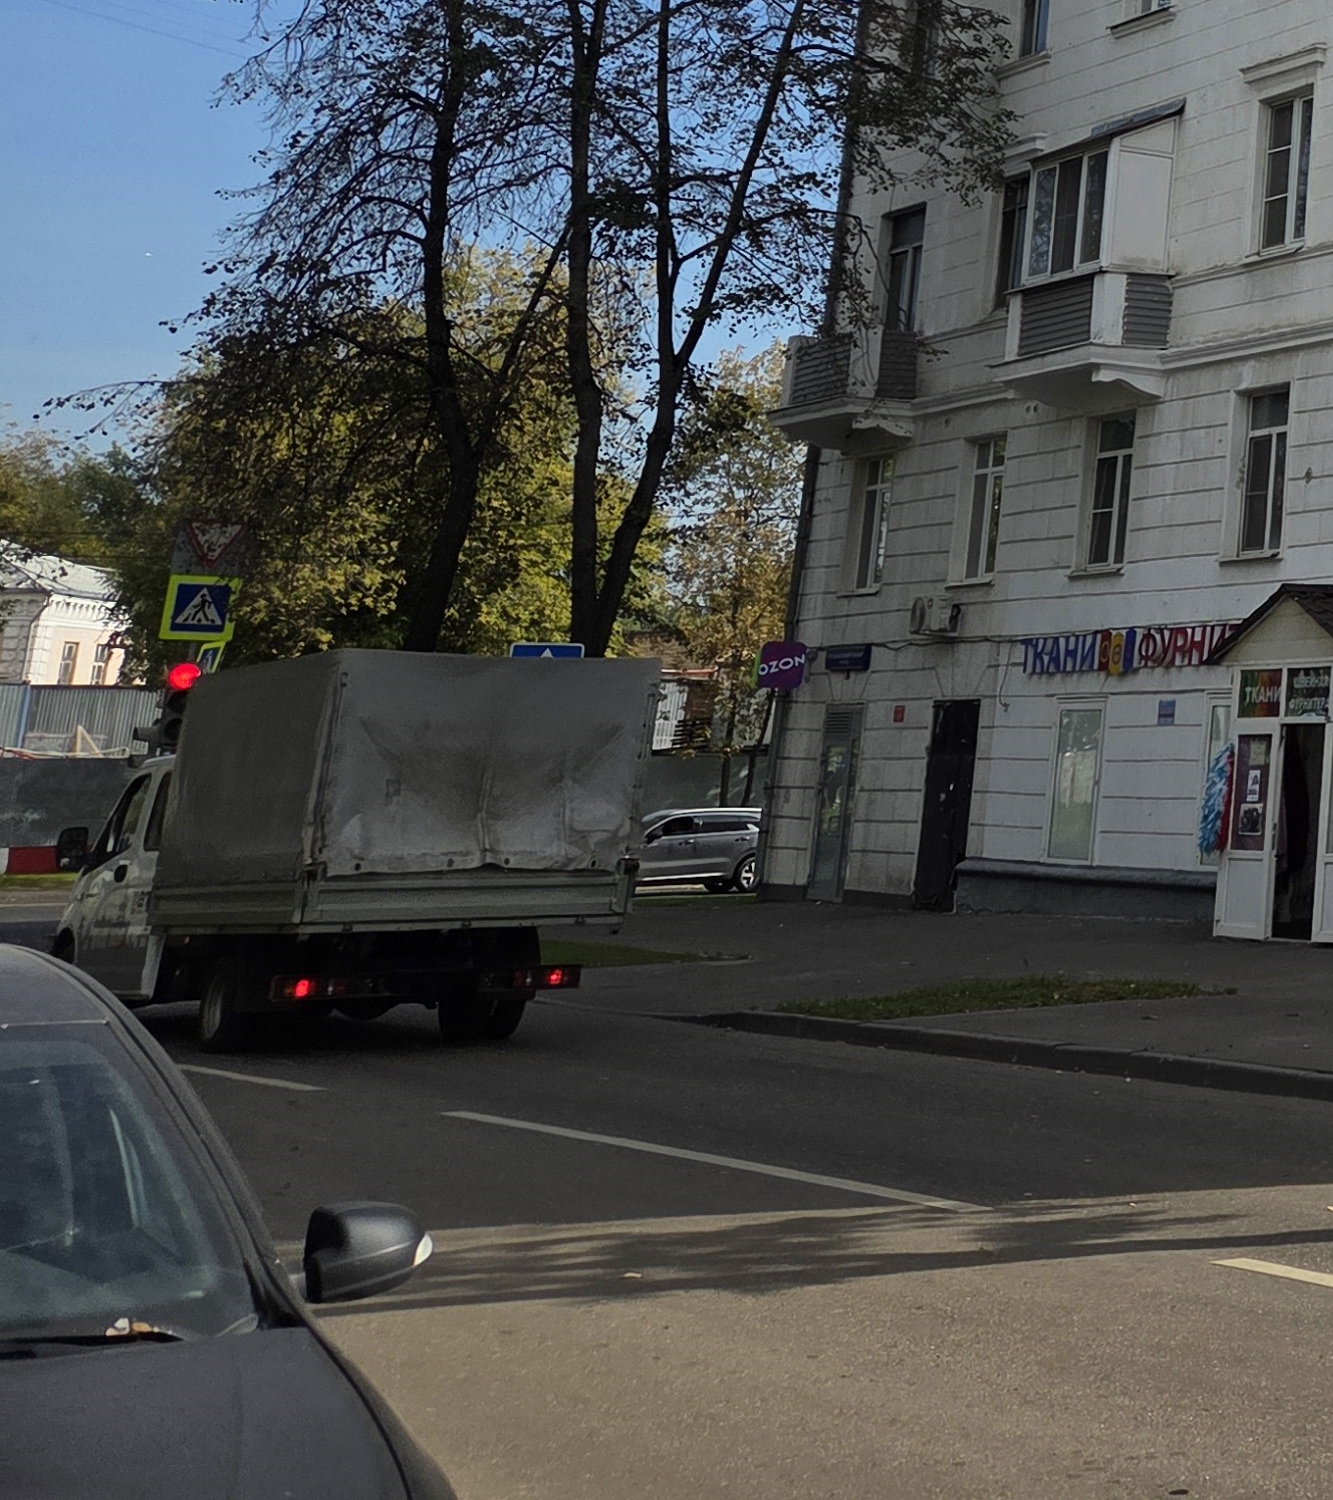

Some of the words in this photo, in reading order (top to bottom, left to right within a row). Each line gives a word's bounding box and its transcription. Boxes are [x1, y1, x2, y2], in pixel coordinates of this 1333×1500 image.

[758, 653, 806, 676] OZON
[1021, 633, 1099, 674] ТКАНИ
[1245, 685, 1281, 704] ТКАНИ
